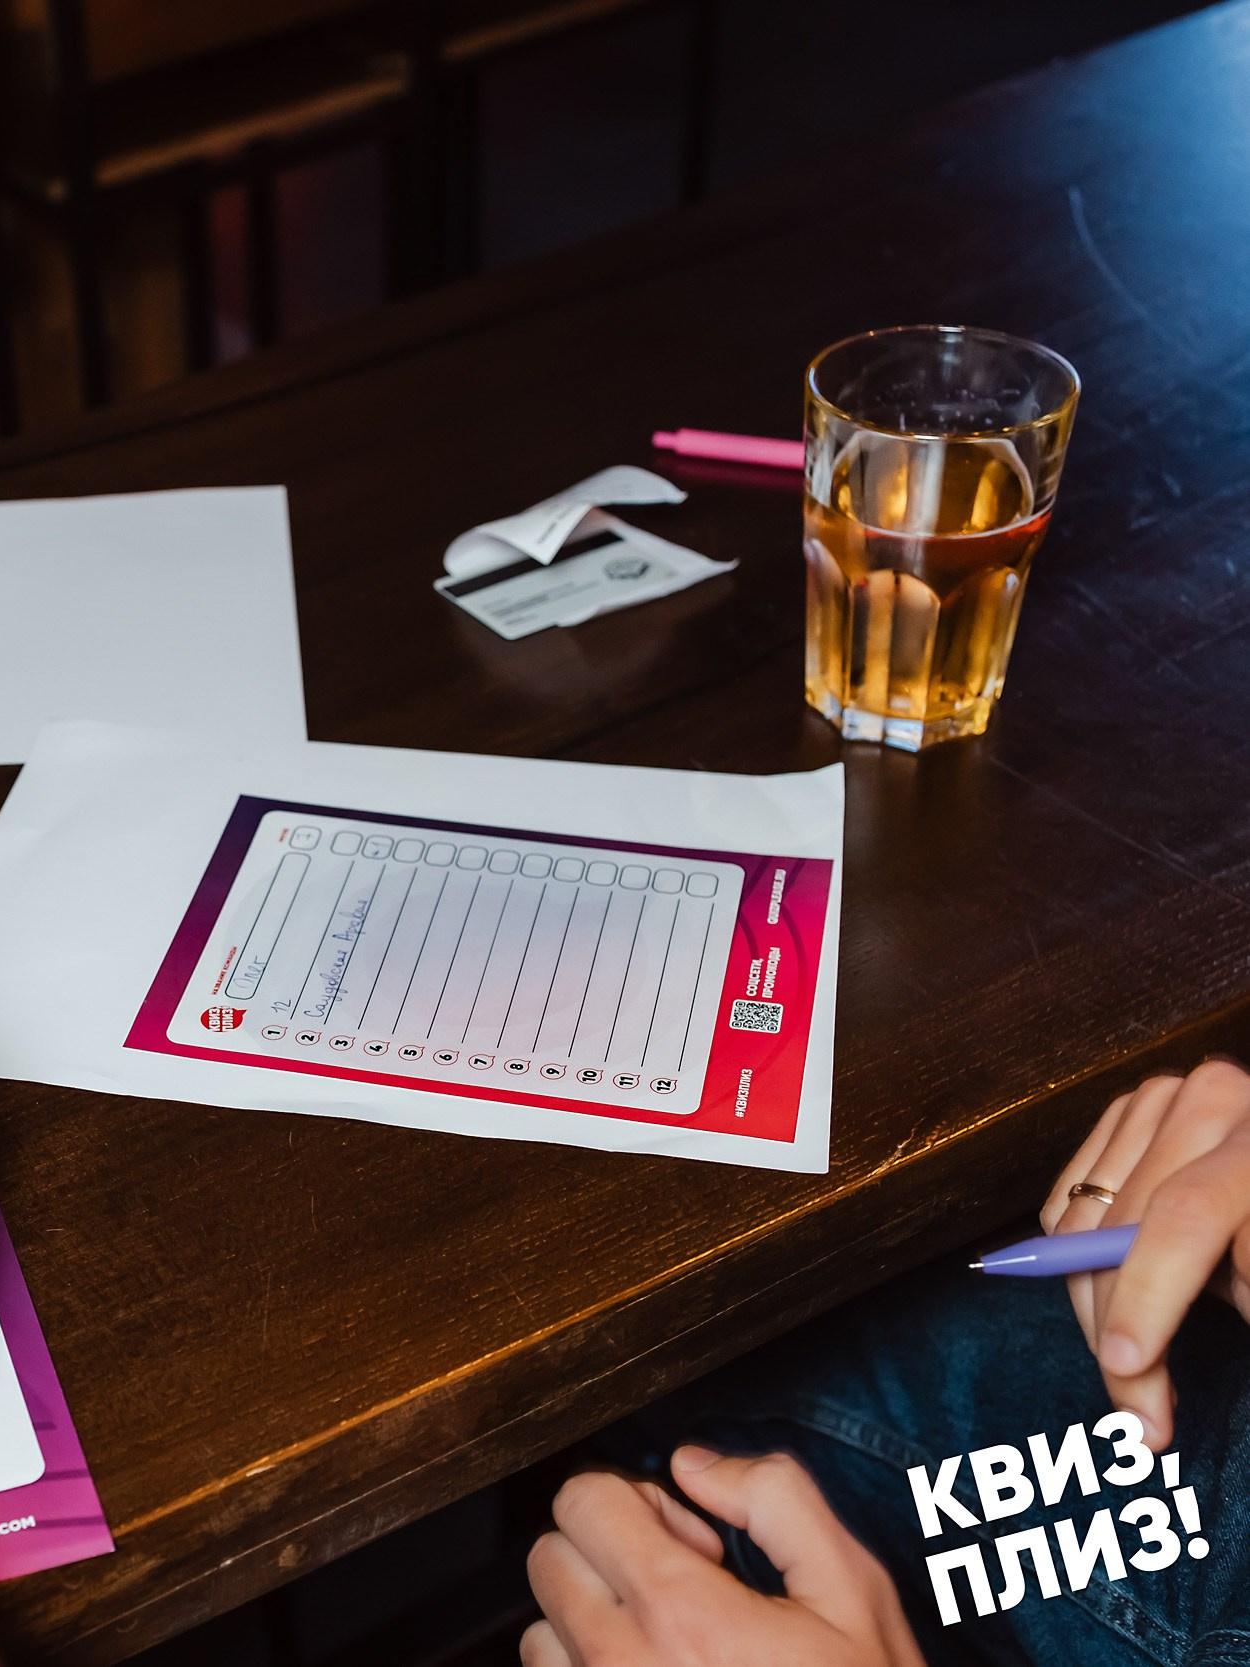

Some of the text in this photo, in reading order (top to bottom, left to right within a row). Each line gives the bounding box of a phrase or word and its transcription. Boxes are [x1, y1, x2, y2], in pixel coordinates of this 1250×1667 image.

[301, 1033, 315, 1042] 2
[334, 1039, 349, 1047] 3
[369, 1044, 383, 1052] 4
[403, 1048, 417, 1057] 5
[438, 1053, 453, 1061] 6
[473, 1057, 488, 1066] 7
[509, 1062, 524, 1071] 8
[546, 1067, 560, 1075] 9
[581, 1070, 598, 1082] 10
[618, 1075, 634, 1086] 11
[656, 1080, 672, 1092] 12
[734, 1068, 753, 1118] #КВИЗПЛИЗ
